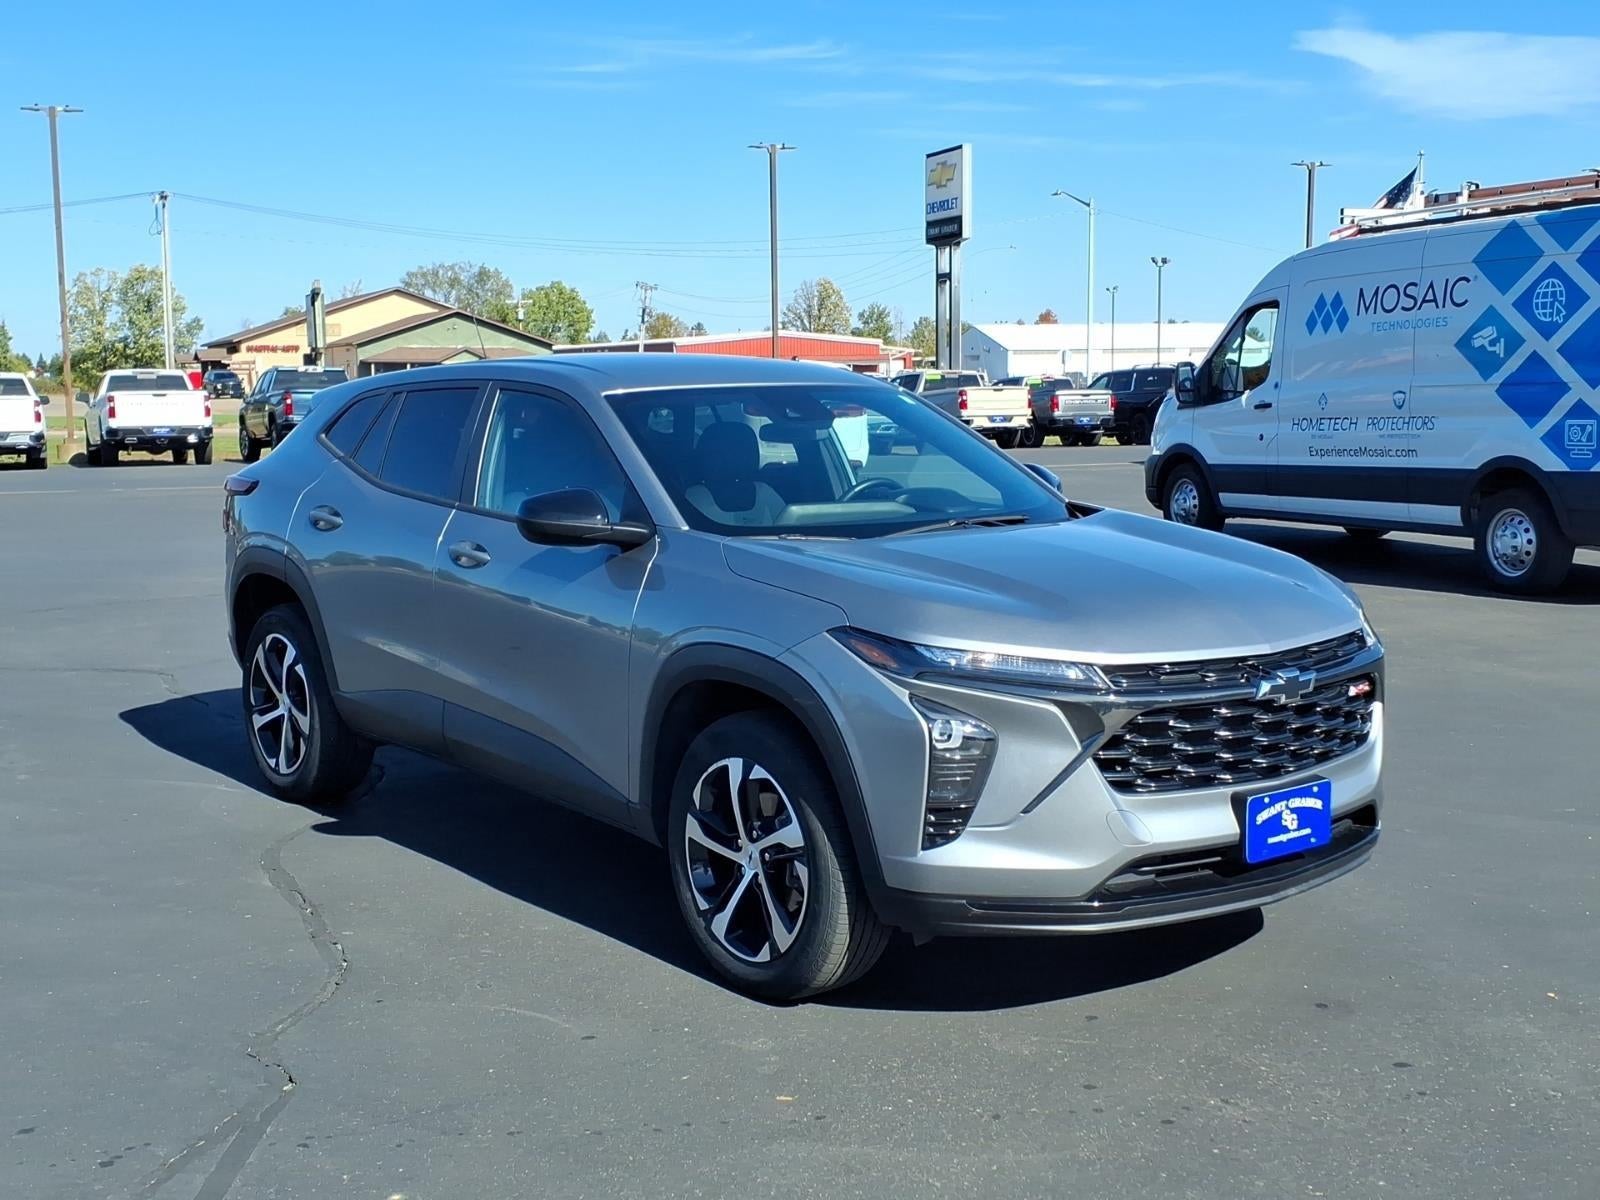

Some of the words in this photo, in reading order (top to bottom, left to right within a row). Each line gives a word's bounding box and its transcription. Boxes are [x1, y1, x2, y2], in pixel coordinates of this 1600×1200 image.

[927, 197, 958, 214] CHEVROLET
[1357, 276, 1471, 316] MOSAIC
[1371, 316, 1448, 332] TECHNOLOGIES
[1291, 417, 1358, 432] HOMETECH
[1366, 416, 1436, 431] PROTECHTORS
[1308, 446, 1418, 459] ExperienceMosaic.com
